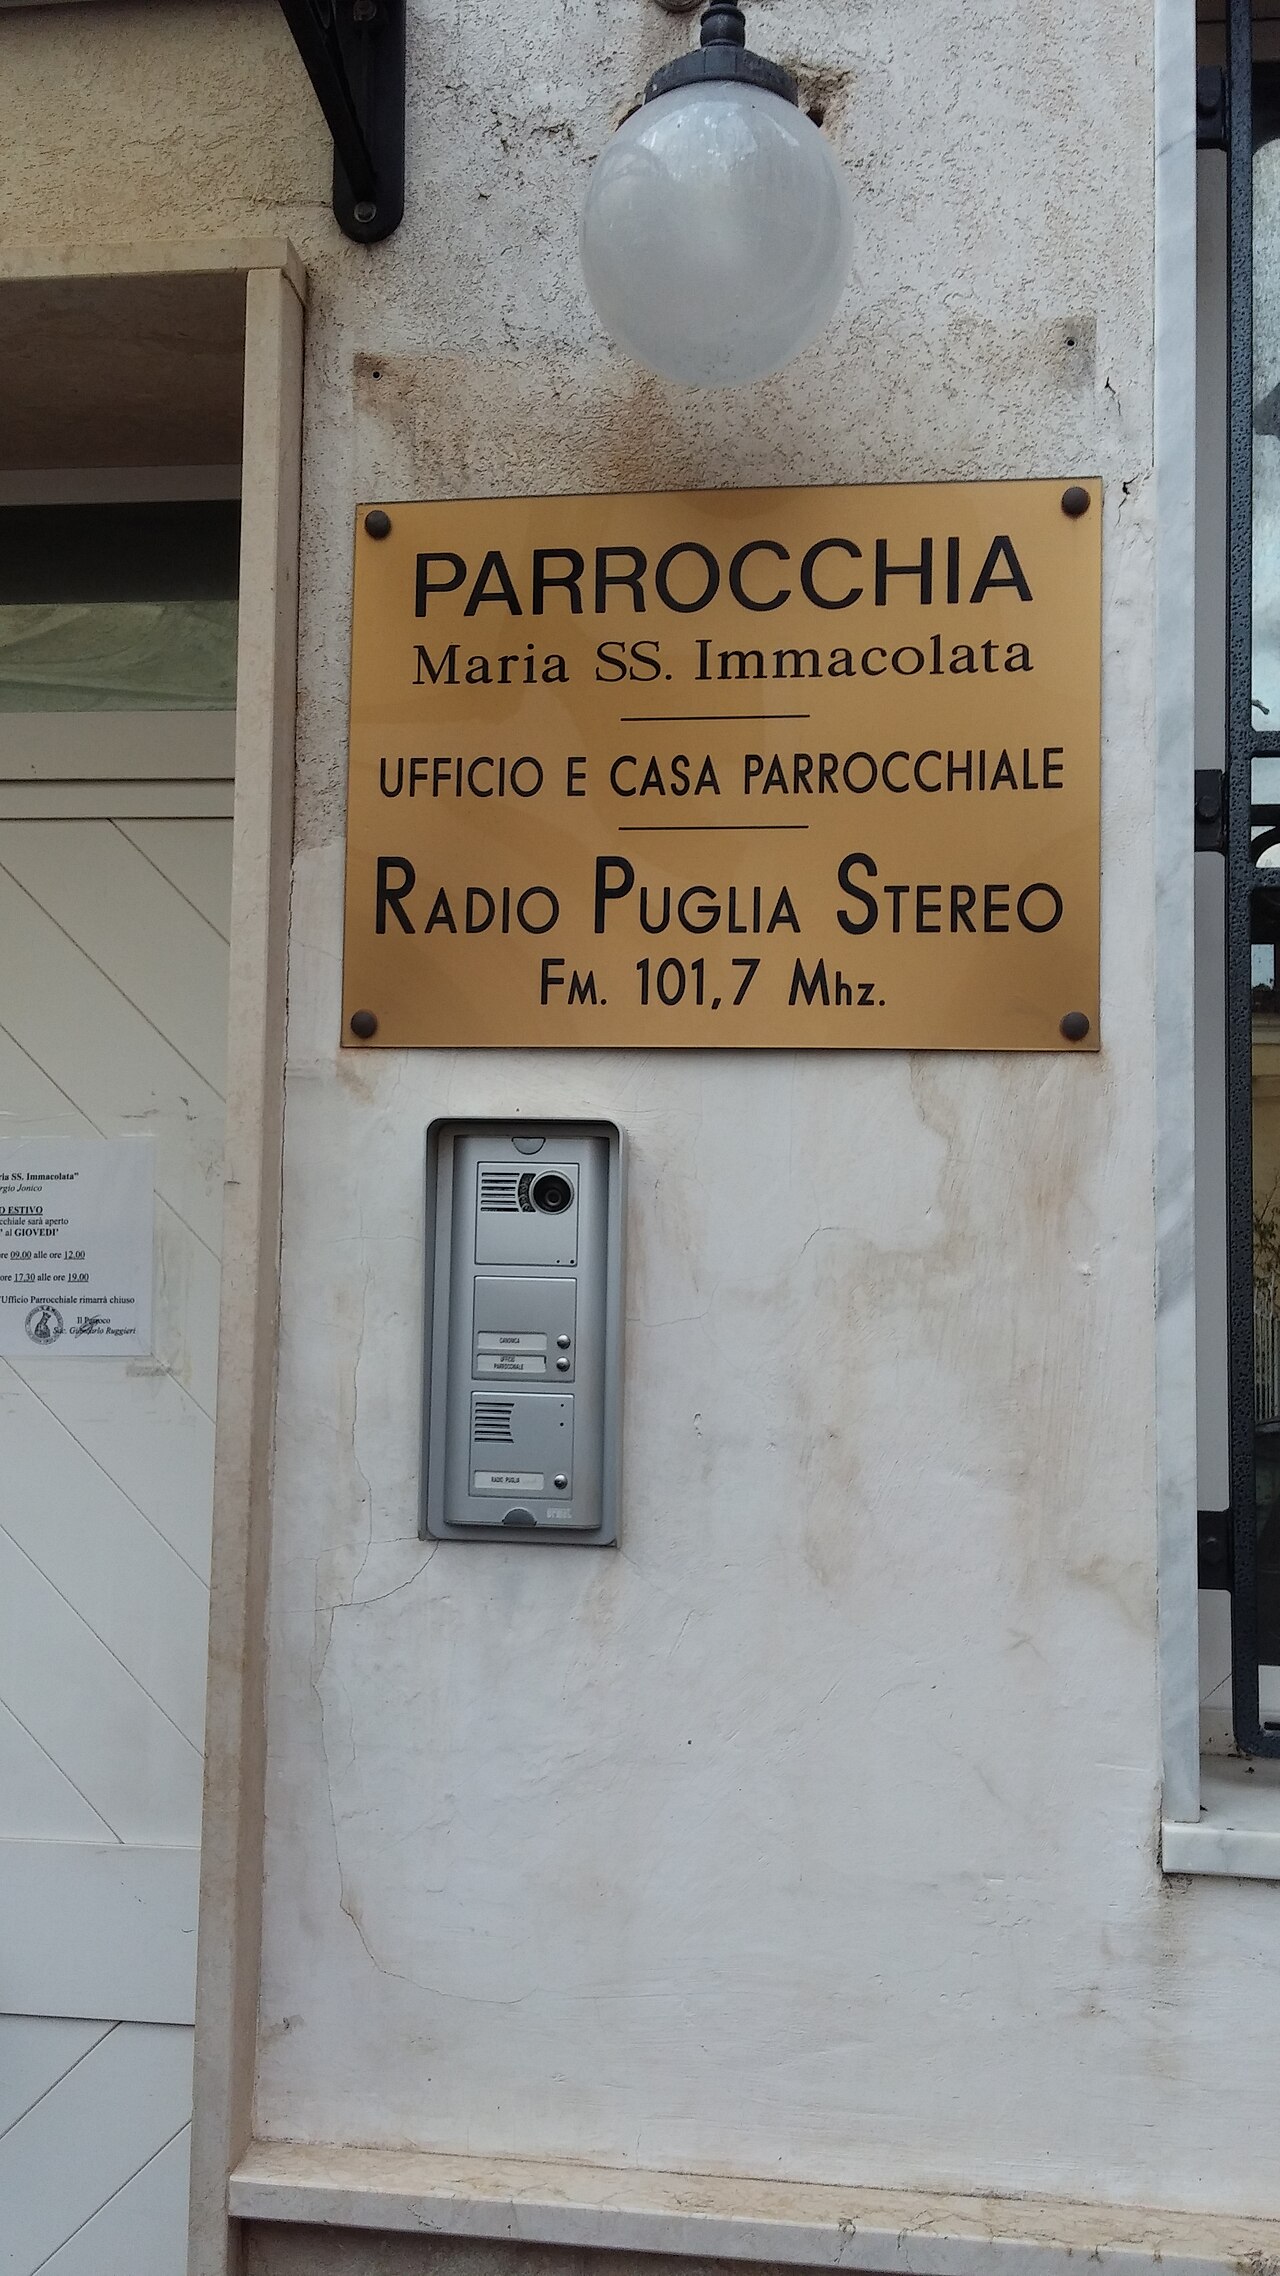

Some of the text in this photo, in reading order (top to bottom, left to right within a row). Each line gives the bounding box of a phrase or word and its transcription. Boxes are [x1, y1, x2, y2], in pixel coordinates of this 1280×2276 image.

[414, 535, 1034, 618] PARROCCHIA
[412, 633, 1034, 685] Maria SS. Immacolata
[379, 746, 1064, 798] UFFICIO E CASA PARROCCHIALE
[636, 958, 761, 1010] 101,7
[789, 958, 886, 1007] Mhz.
[11, 1173, 25, 1181] SS.
[17, 1184, 43, 1192] Jonico
[8, 1206, 43, 1215] ESTIVO
[45, 1218, 69, 1227] aperto
[10, 1250, 32, 1260] 09.00
[33, 1251, 48, 1259] alle
[64, 1250, 86, 1260] 12.00
[14, 1273, 36, 1283] 17.30
[37, 1273, 52, 1282] alle
[67, 1273, 90, 1283] 19.00
[30, 1295, 78, 1304] Parrocchiale
[109, 1296, 136, 1304] chiuso
[105, 1327, 137, 1336] Ruggieri
